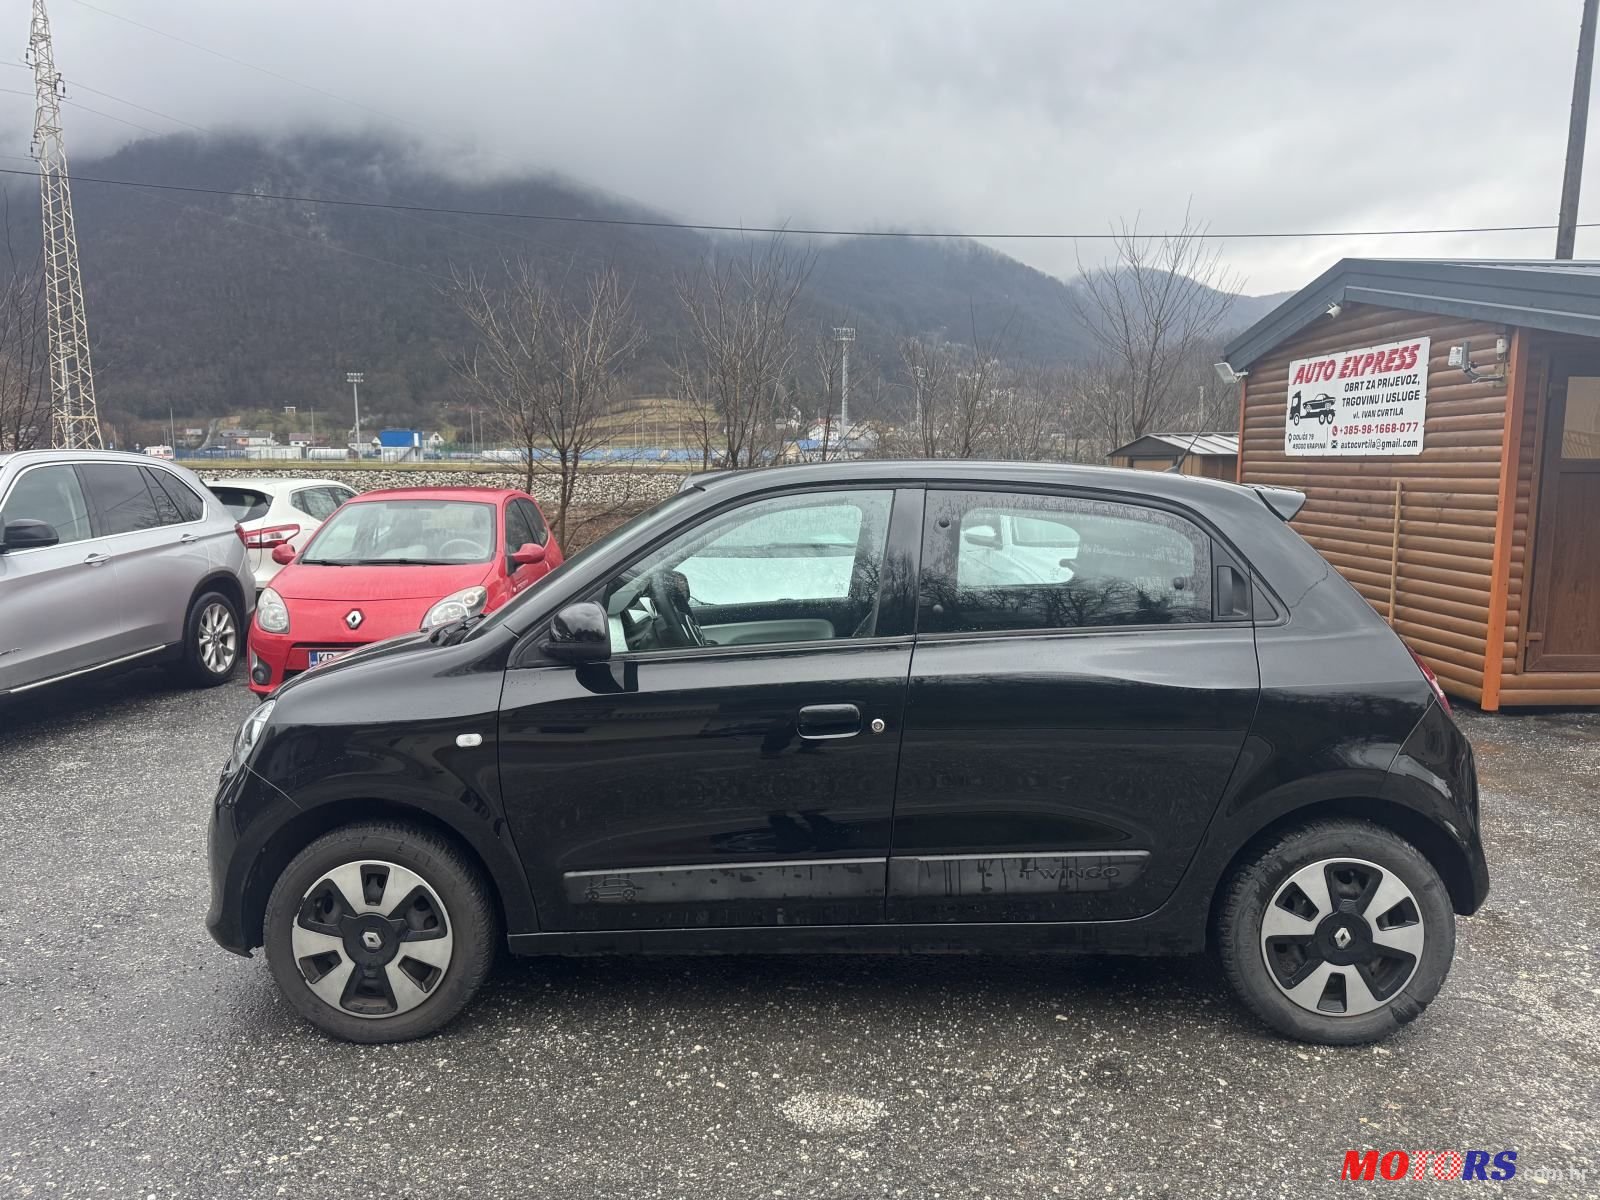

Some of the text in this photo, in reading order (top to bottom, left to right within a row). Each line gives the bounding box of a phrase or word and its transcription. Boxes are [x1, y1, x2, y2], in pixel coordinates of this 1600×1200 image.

[1292, 359, 1337, 385] AUTO
[1337, 344, 1421, 379] EXPRESS
[1344, 373, 1420, 392] OBRT ZA PRIJEVOZ,
[1342, 393, 1380, 407] TRGOVINU
[1385, 390, 1420, 403] USLUGE
[1361, 409, 1375, 418] IVAN
[1376, 407, 1404, 417] CVRTILA
[1340, 422, 1419, 435] +385-98-1668-077
[1341, 438, 1418, 450] autocvrtila@gmail.com
[1020, 866, 1120, 880] TWINGO
